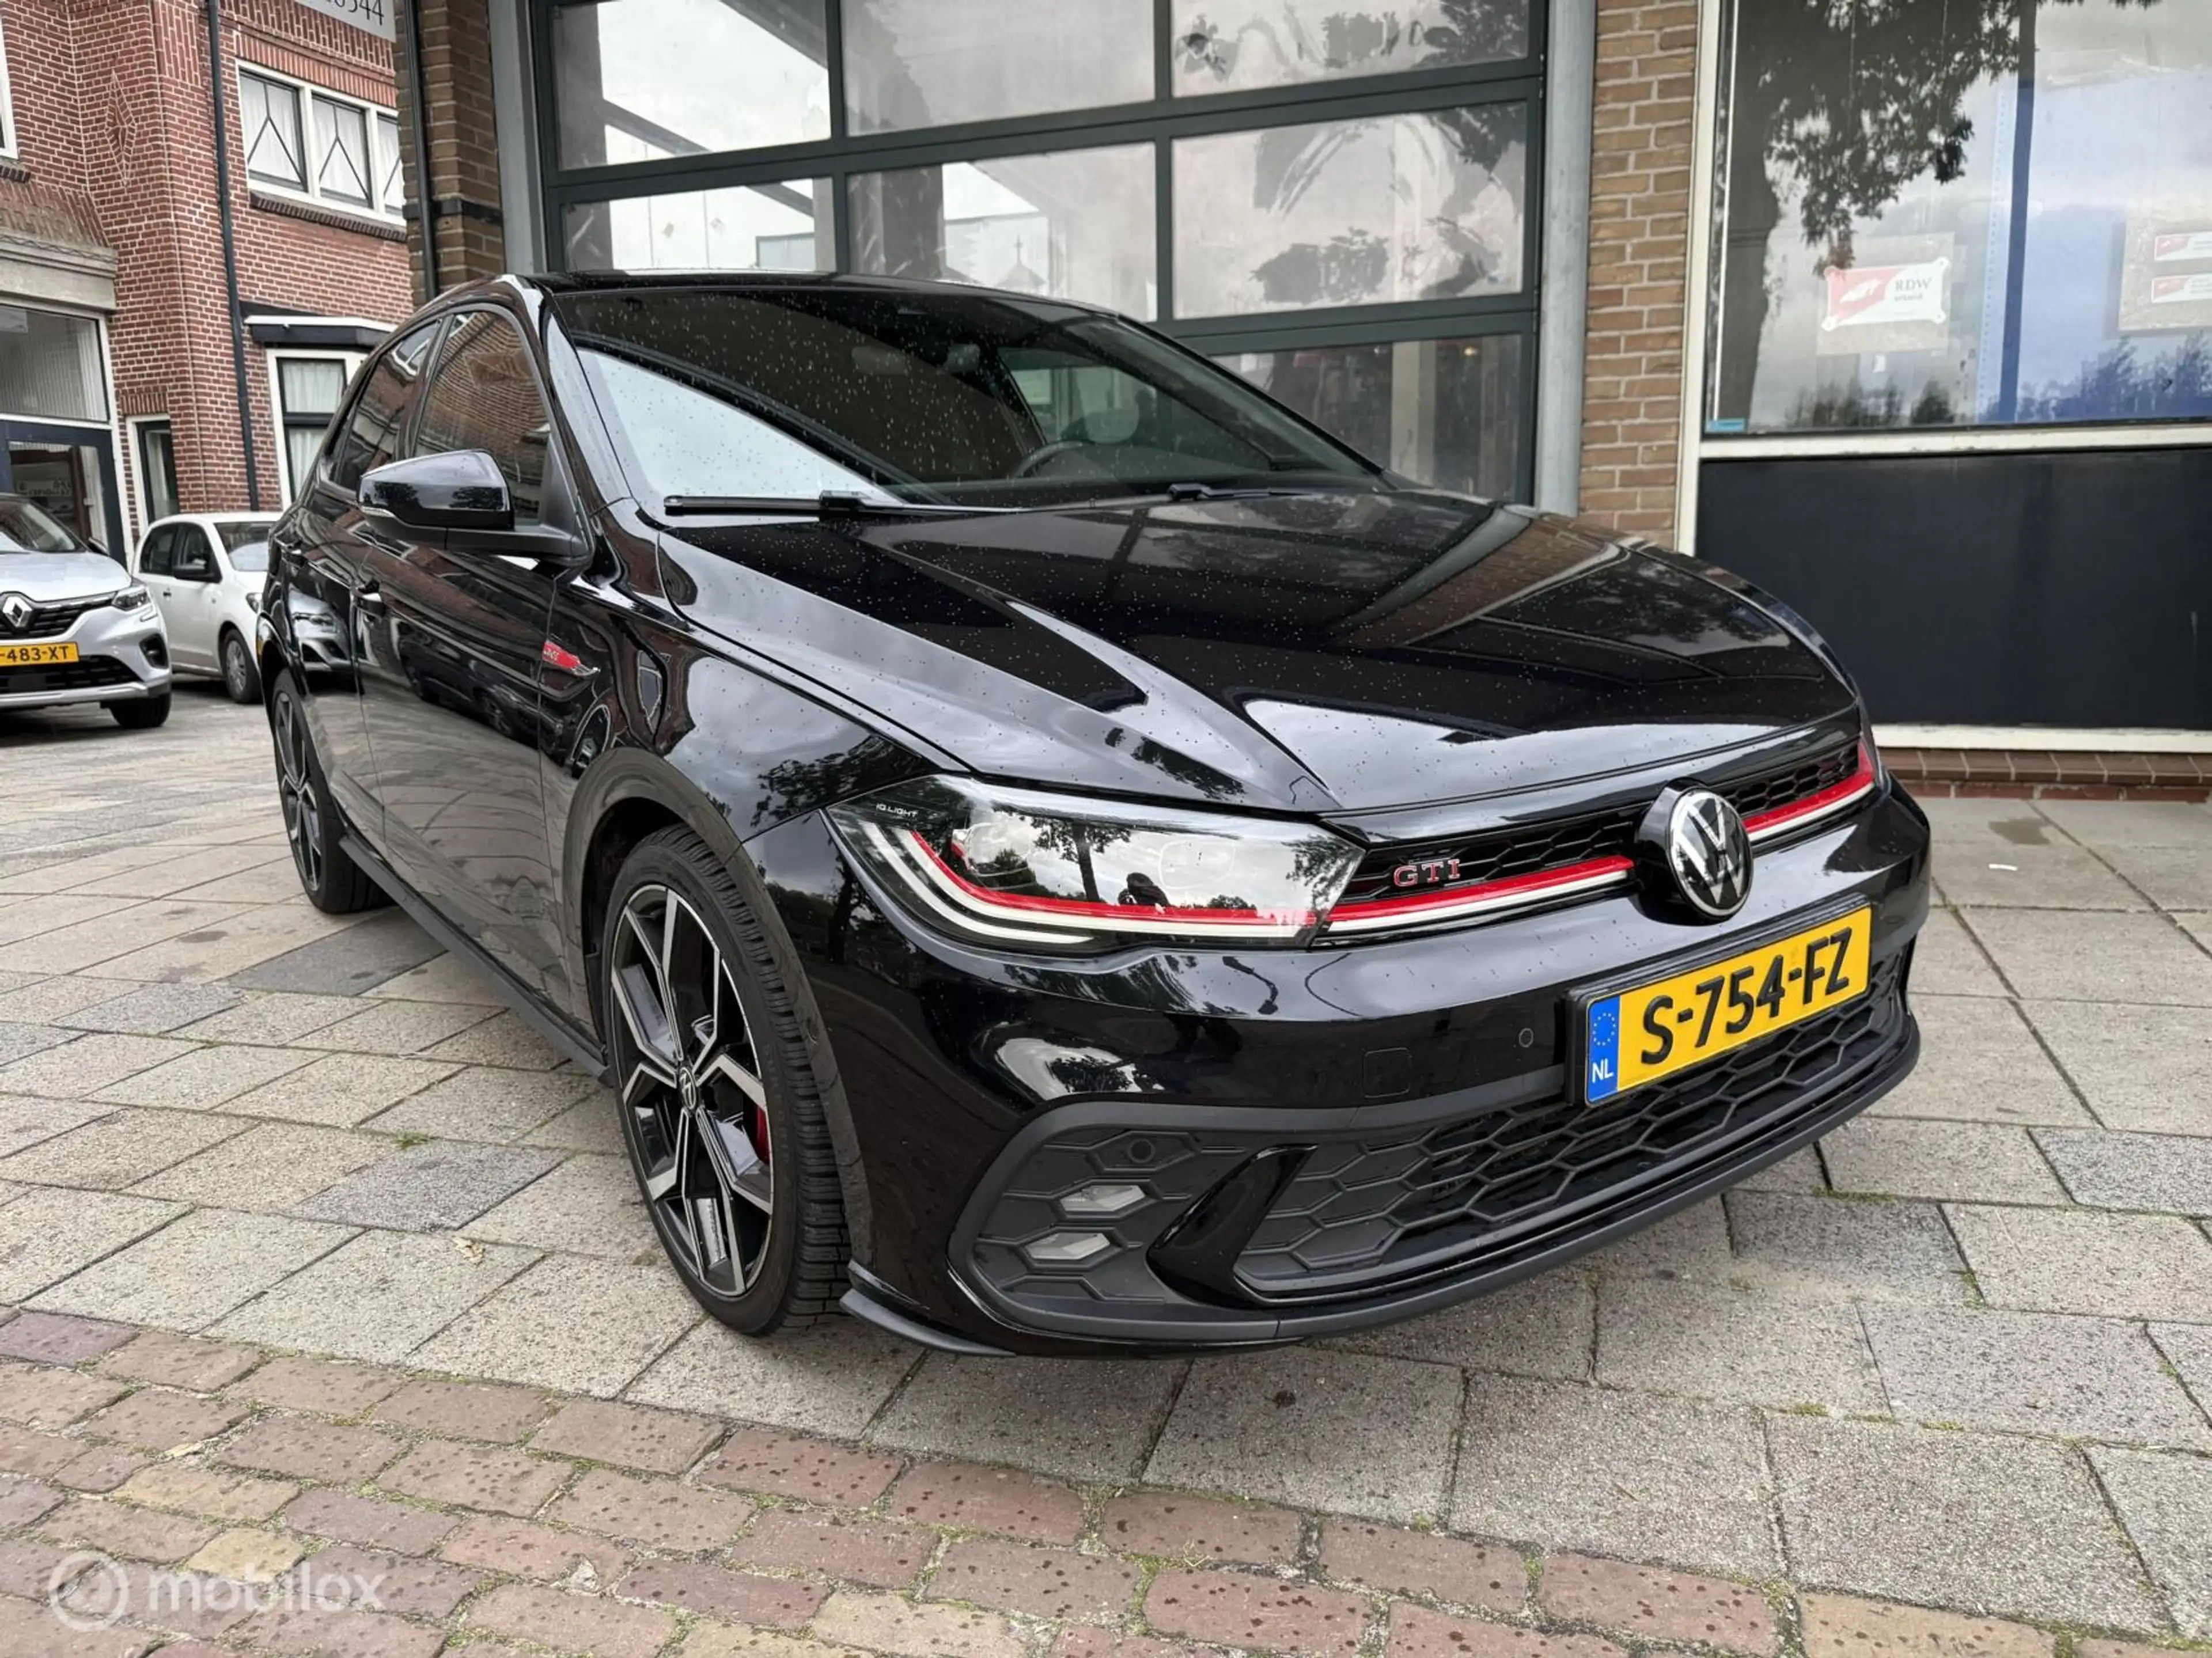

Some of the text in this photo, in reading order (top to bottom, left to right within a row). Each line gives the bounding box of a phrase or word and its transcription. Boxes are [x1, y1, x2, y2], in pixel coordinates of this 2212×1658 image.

[1393, 859, 1460, 886] GTI
[1641, 926, 1853, 1065] S-754-FZ
[1592, 1058, 1613, 1084] NL
